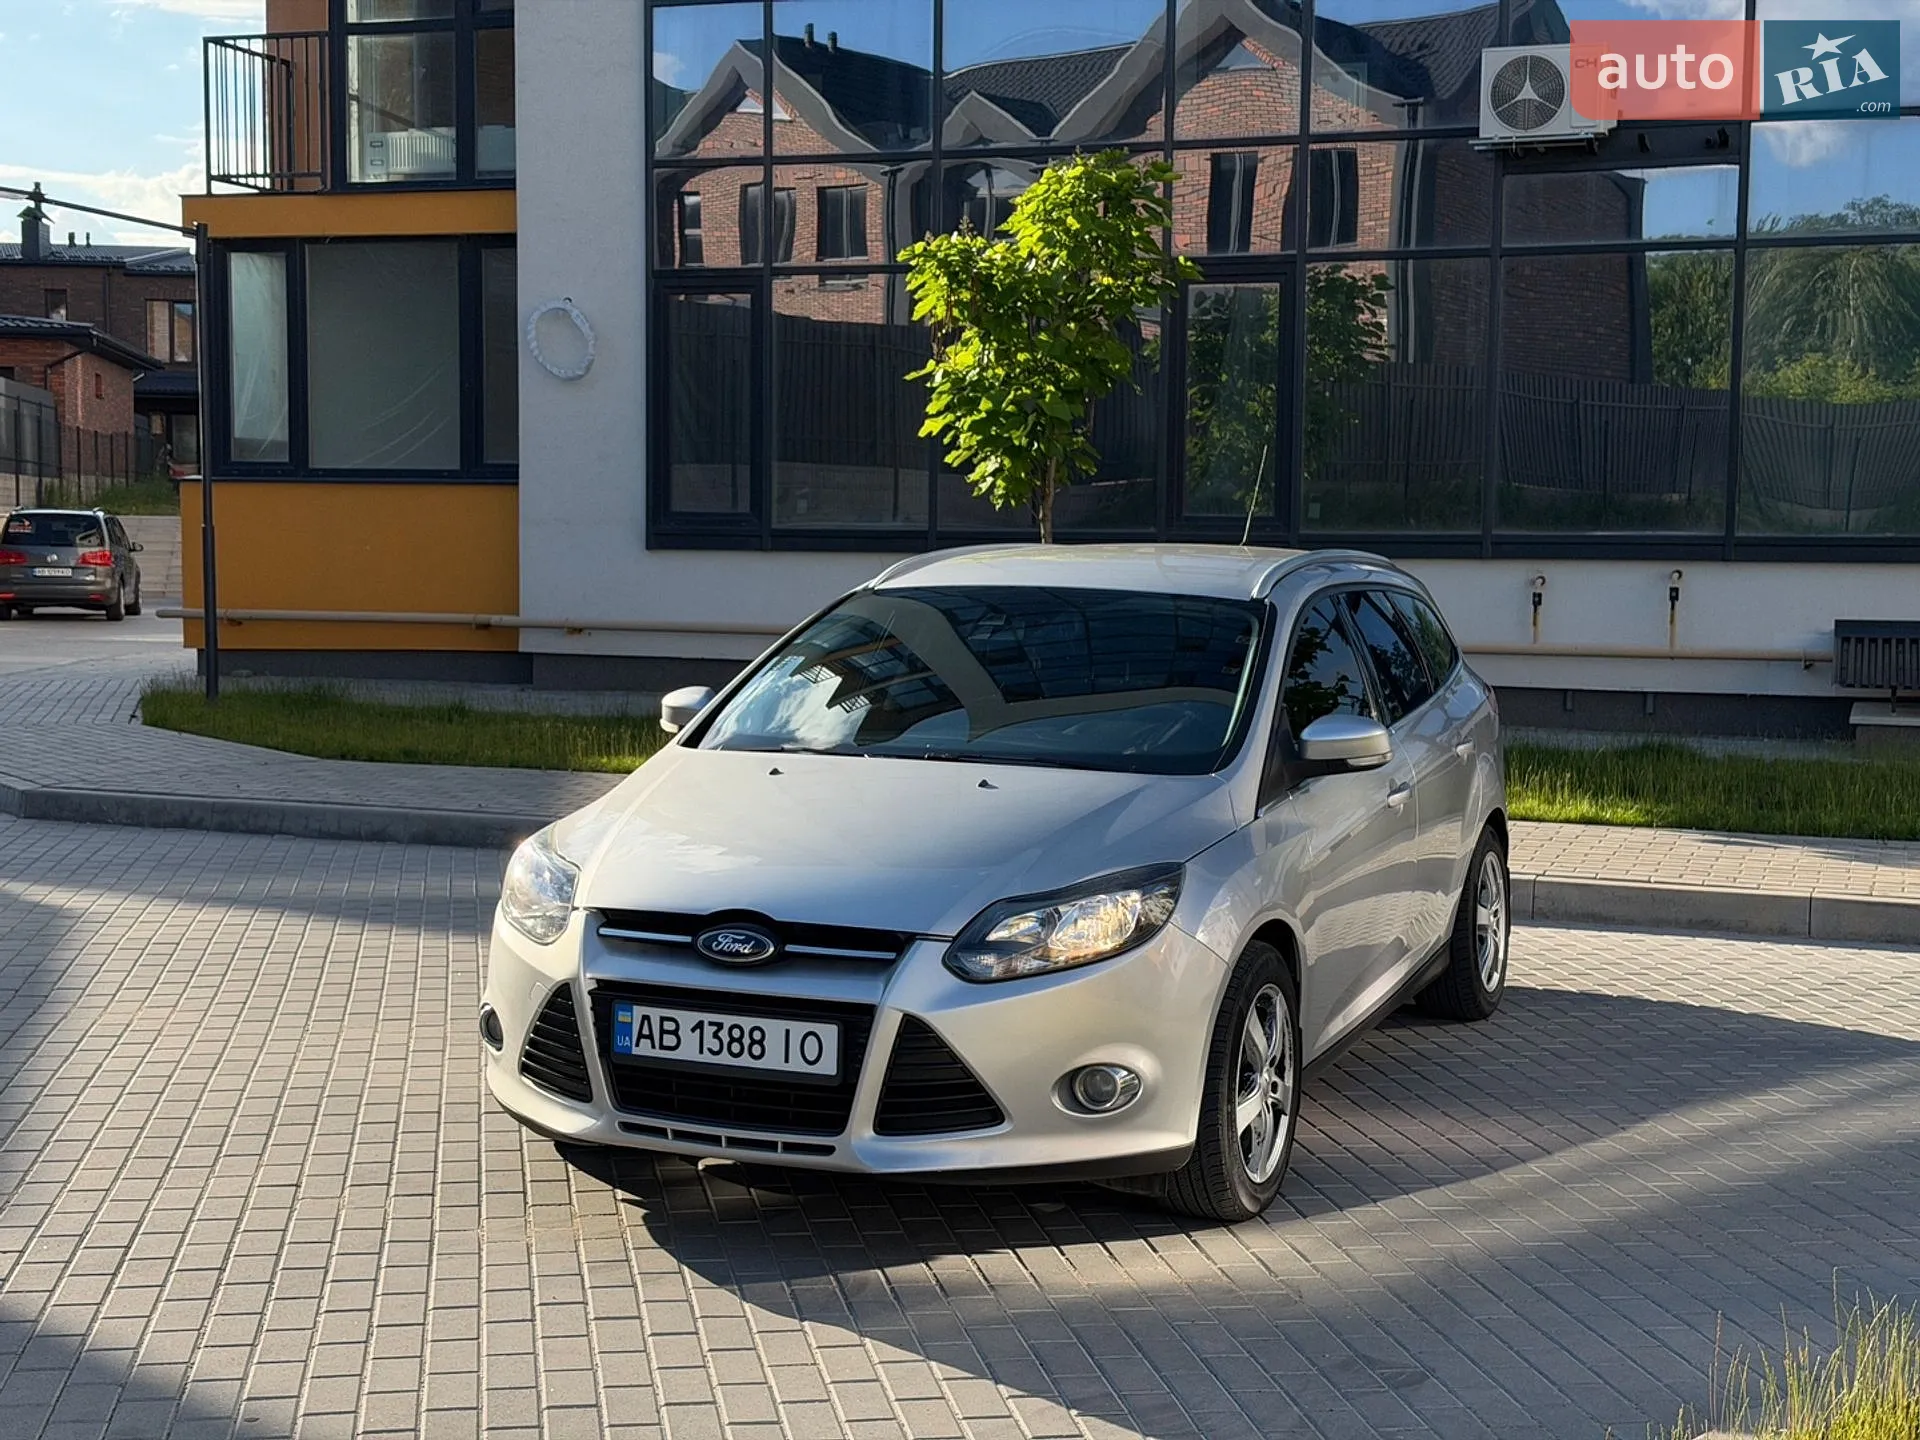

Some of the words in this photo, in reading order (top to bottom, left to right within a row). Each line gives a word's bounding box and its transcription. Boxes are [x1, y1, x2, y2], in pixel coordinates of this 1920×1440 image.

[711, 933, 754, 954] Ford
[617, 1035, 631, 1047] UA
[635, 1014, 682, 1051] AB
[690, 1020, 766, 1060] 1388
[784, 1028, 823, 1066] IO
